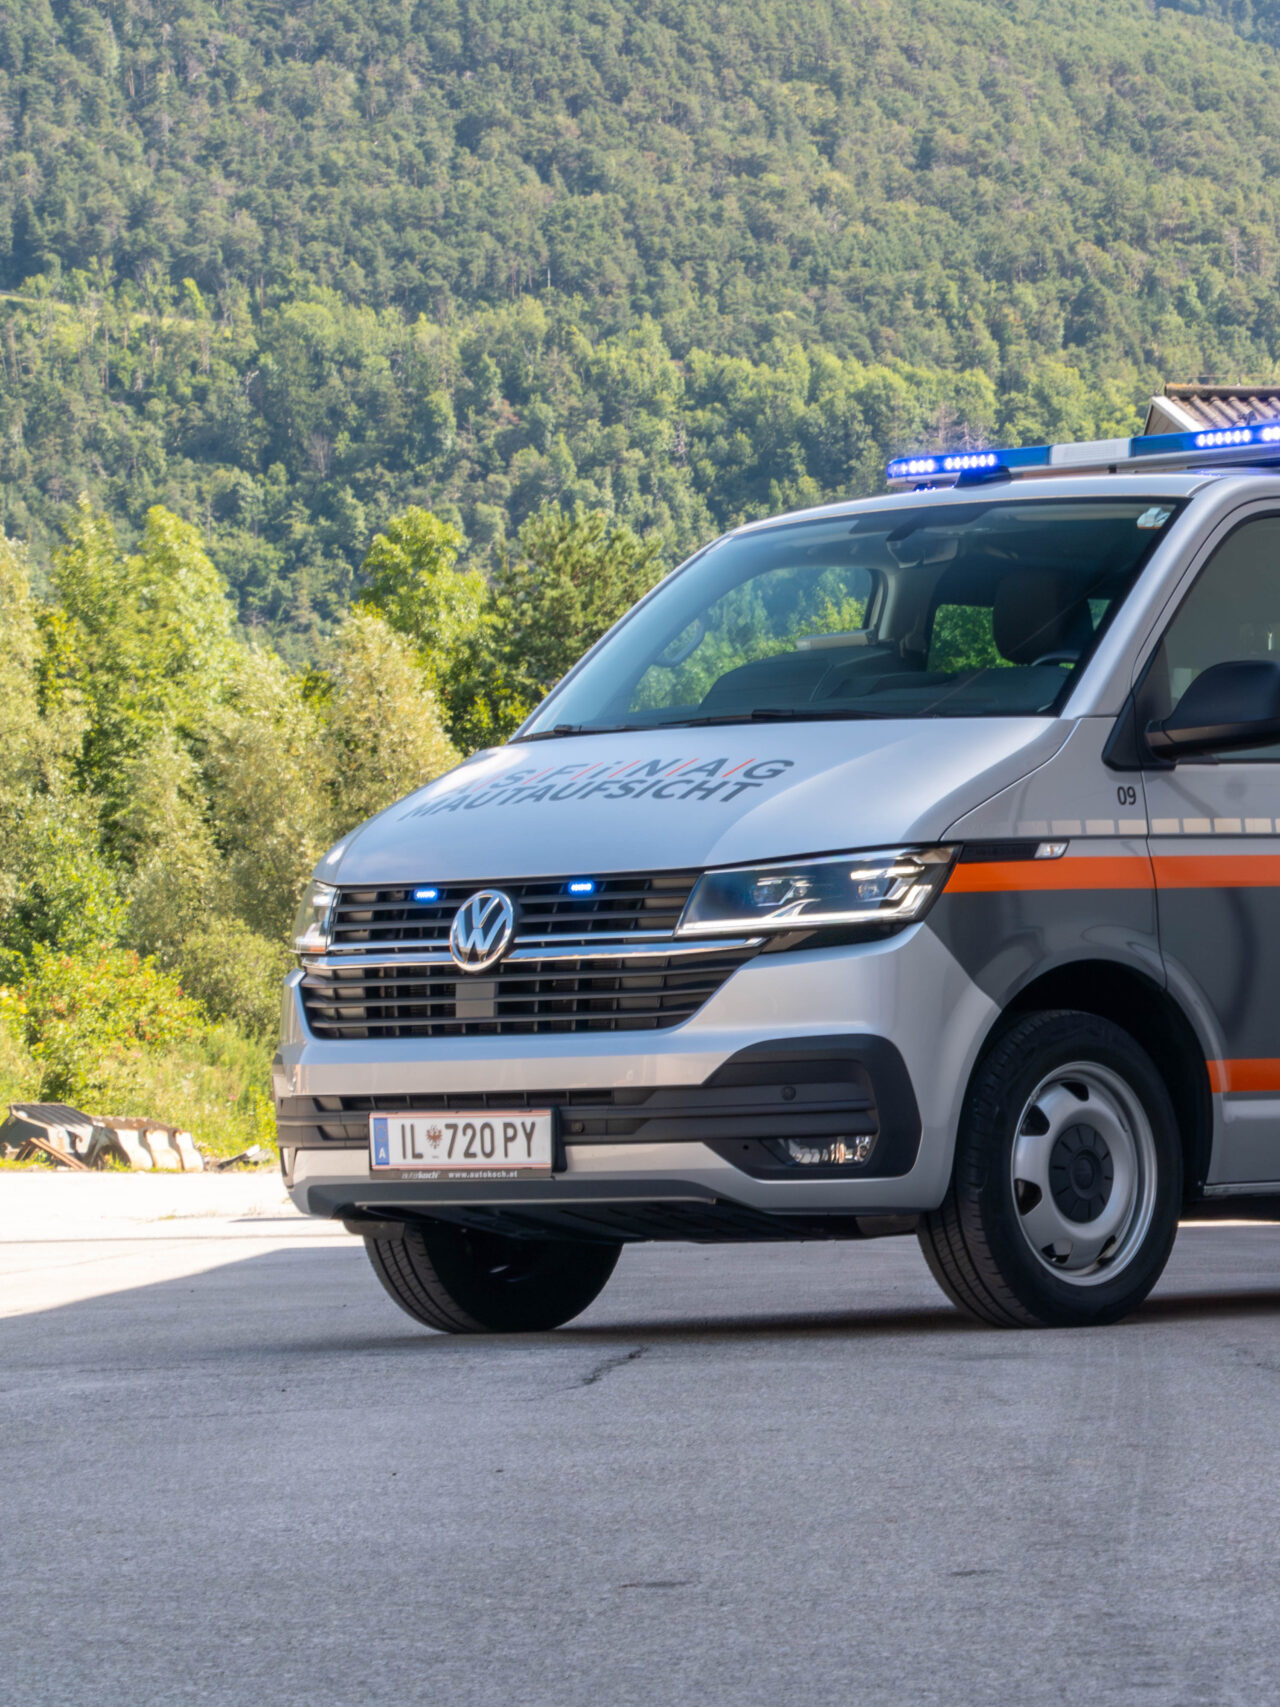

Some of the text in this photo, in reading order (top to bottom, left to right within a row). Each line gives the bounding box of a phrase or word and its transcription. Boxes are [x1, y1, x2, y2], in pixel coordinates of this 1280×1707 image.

[397, 779, 763, 823] MAUTAUFSICHT
[1117, 786, 1136, 805] 09
[449, 889, 513, 971] VW
[378, 1147, 386, 1159] A
[401, 1121, 536, 1160] IL 720 PY
